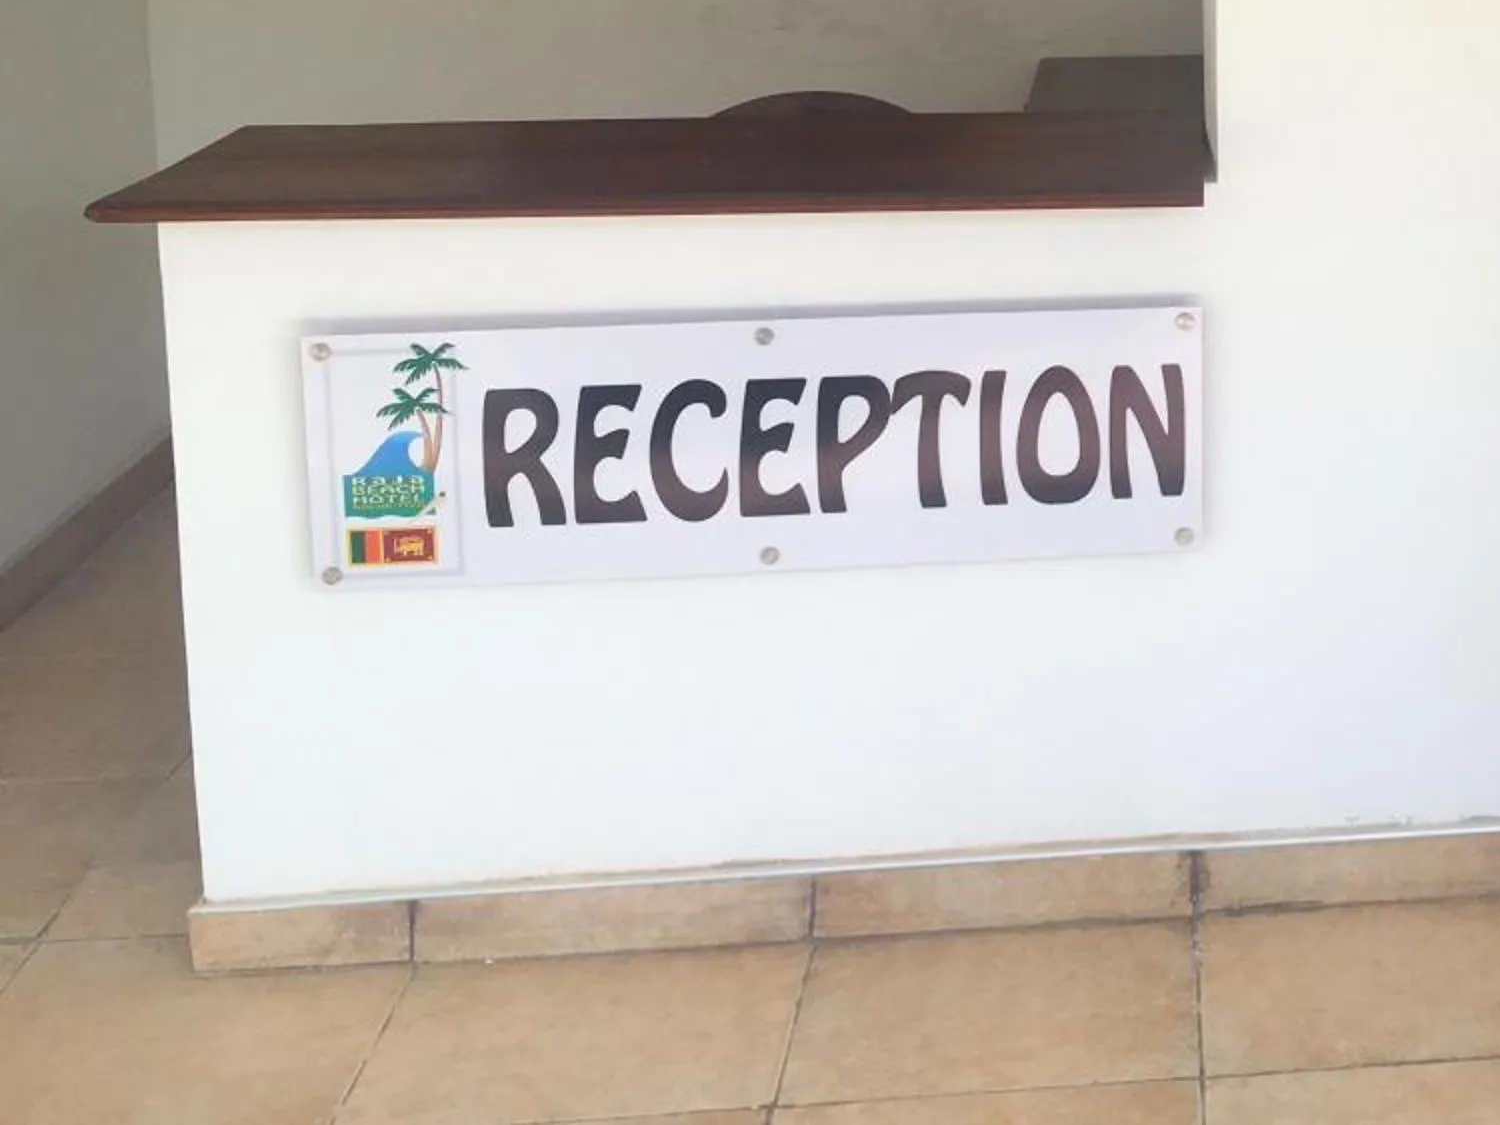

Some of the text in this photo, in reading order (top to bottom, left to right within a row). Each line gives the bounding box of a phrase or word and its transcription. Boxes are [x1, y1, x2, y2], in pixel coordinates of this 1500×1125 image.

[482, 363, 1185, 528] RECEPTION
[352, 485, 425, 495] BEACH
[352, 494, 421, 504] HOTEL
